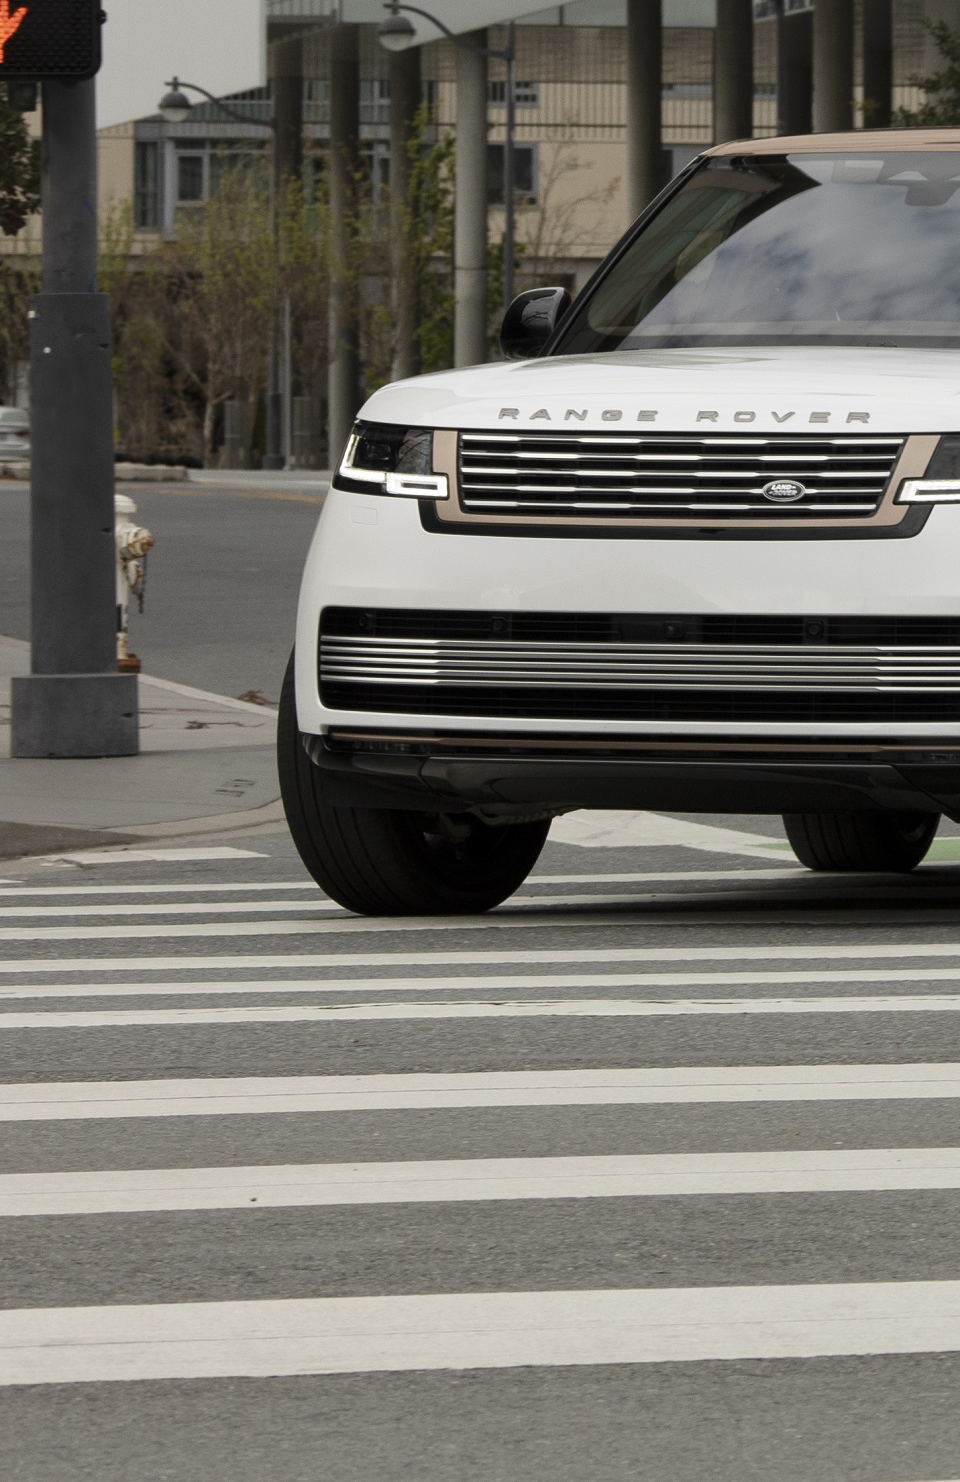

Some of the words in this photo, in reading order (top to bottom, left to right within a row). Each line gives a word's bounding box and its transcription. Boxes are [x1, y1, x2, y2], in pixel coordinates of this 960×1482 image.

[498, 407, 659, 422] RANGE
[695, 410, 871, 424] ROVER
[771, 483, 792, 491] LAND
